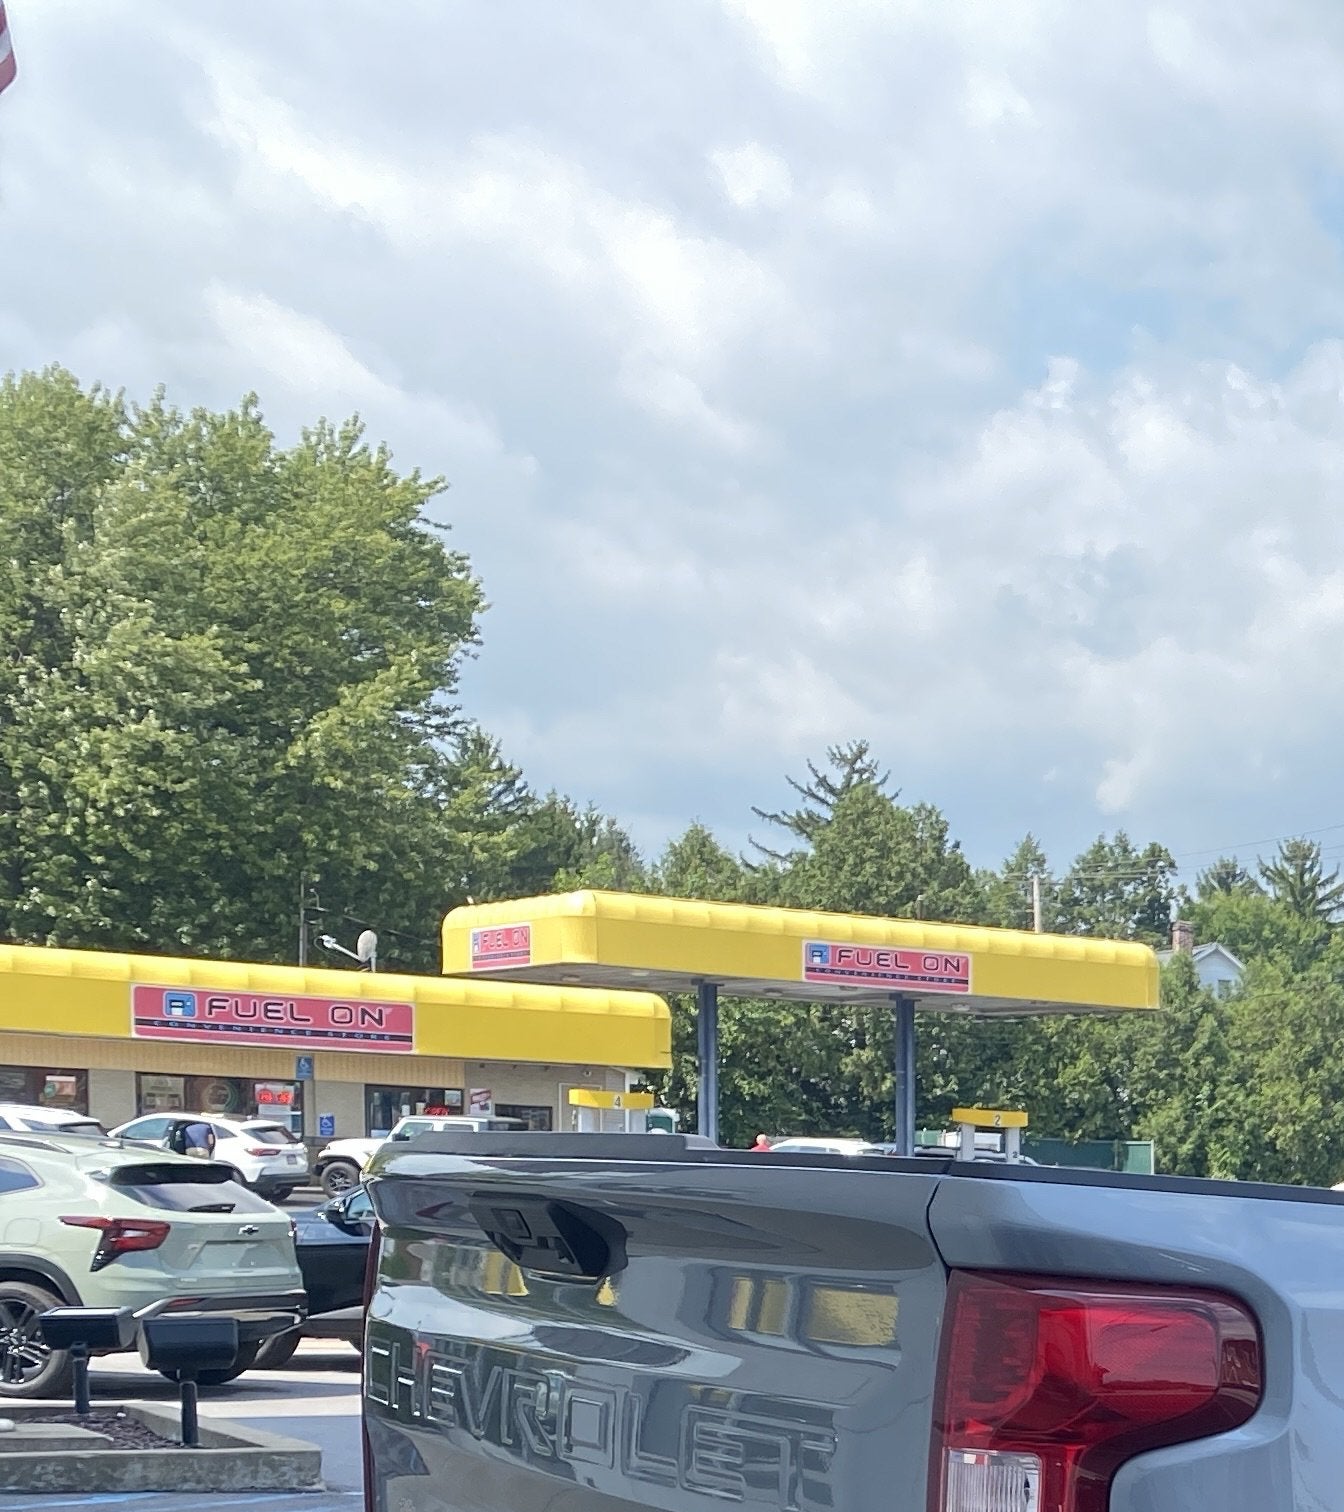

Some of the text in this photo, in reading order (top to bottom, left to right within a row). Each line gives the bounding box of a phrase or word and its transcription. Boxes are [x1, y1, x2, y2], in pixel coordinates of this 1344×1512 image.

[836, 948, 962, 974] FUEL ON
[205, 996, 386, 1028] FUEL ON
[994, 1114, 1002, 1127] 2
